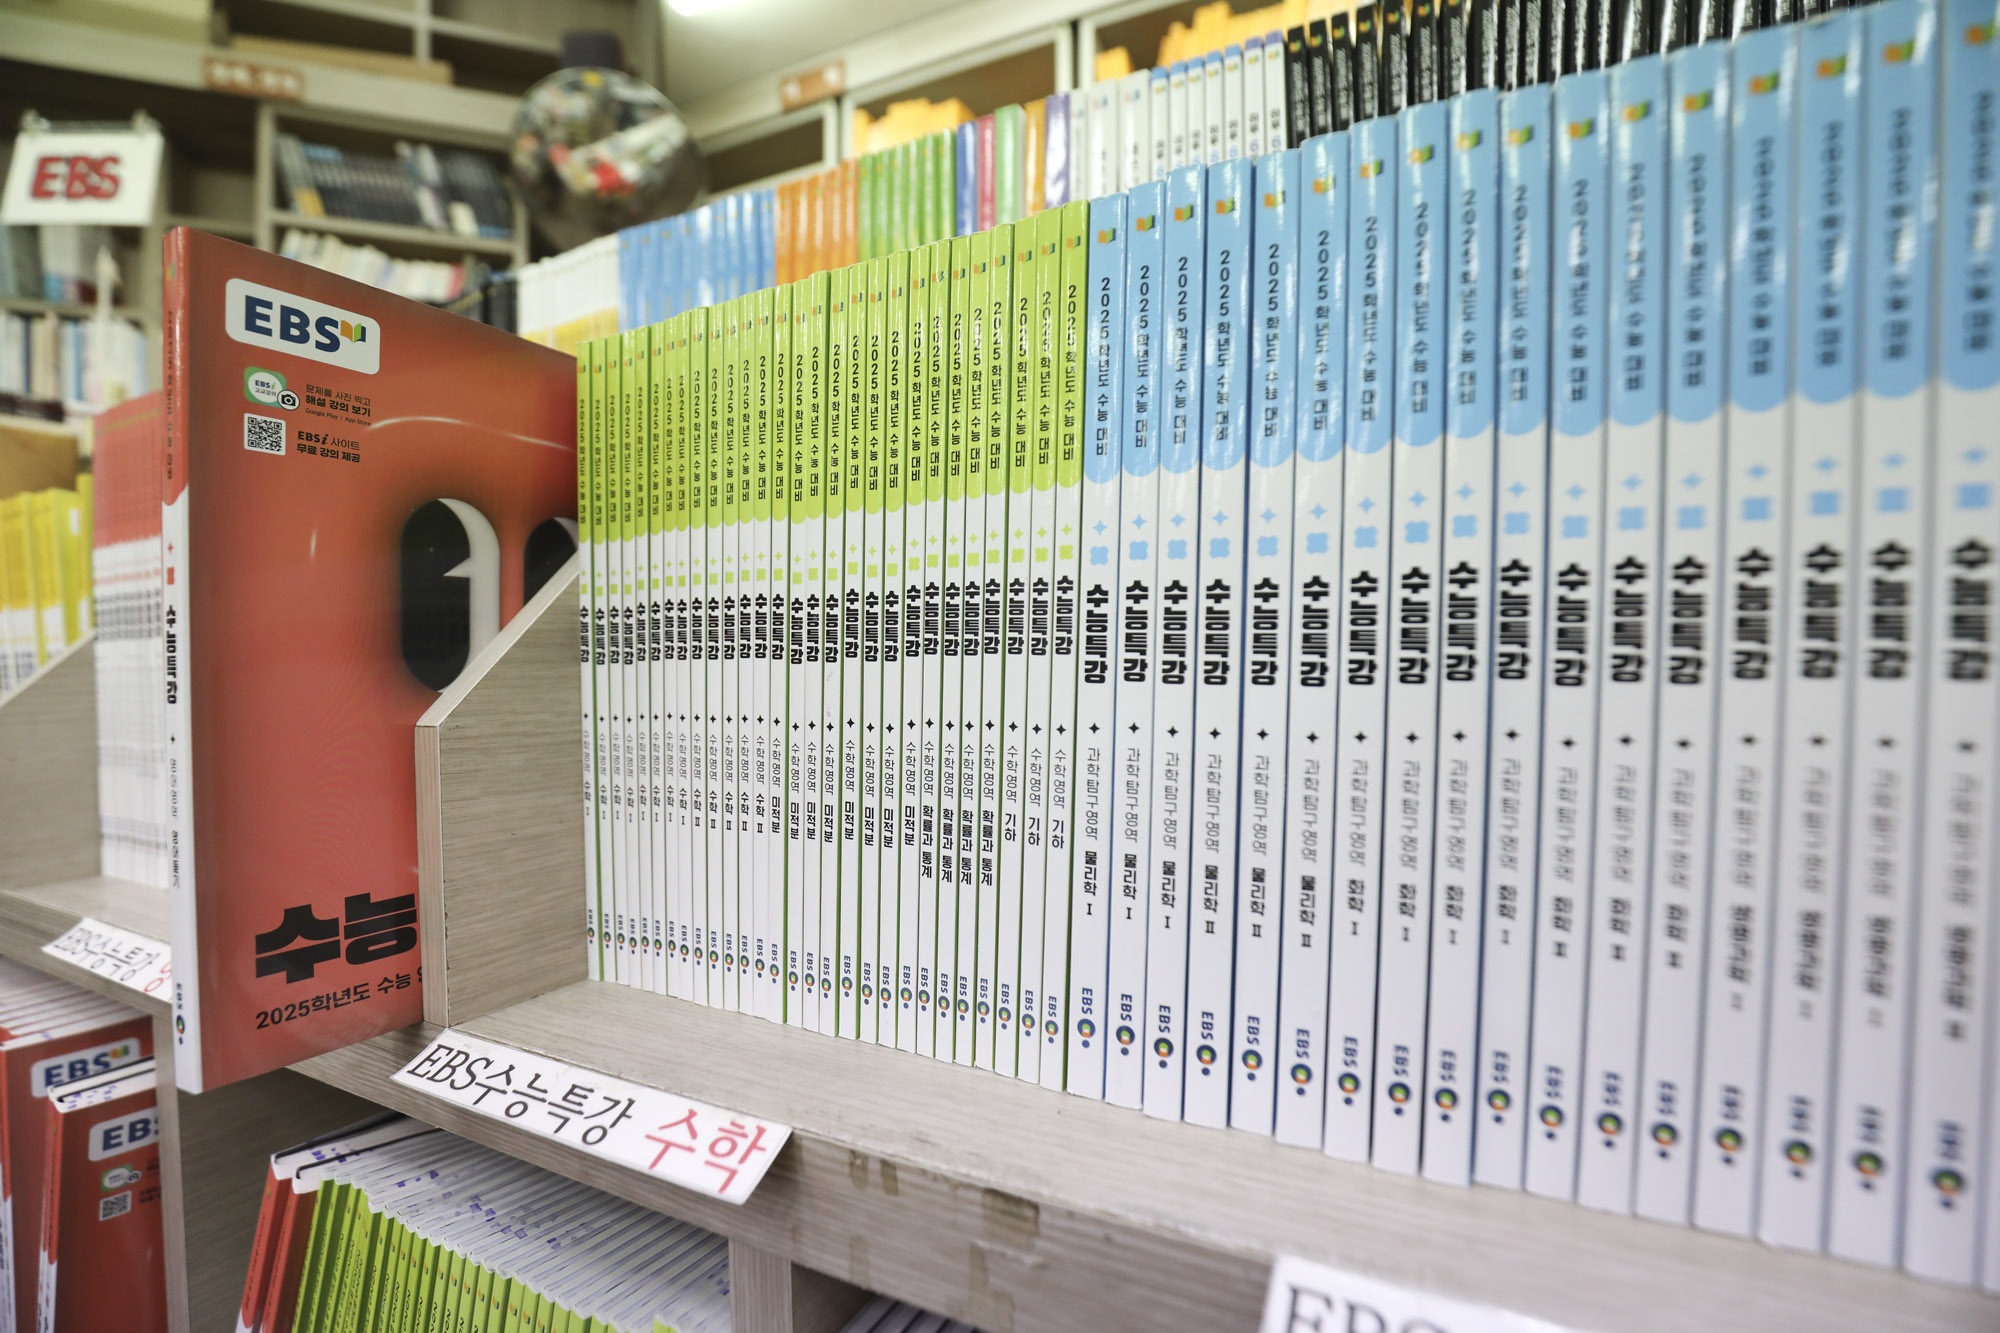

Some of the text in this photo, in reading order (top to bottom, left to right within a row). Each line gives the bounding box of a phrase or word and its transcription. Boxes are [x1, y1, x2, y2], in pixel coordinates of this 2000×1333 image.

[30, 155, 121, 200] EBS
[245, 294, 341, 353] EBS
[255, 380, 276, 390] EBSi
[305, 395, 371, 417] 해설 강의 보기
[306, 384, 371, 406] 문제를 사진 찍고
[1097, 393, 1109, 421] 수능
[1137, 384, 1149, 413] 수능
[1217, 376, 1229, 405] 수능
[298, 430, 360, 451] EBSi 사이트
[305, 408, 325, 417] Google
[326, 412, 339, 420] Play
[345, 416, 357, 424] App
[931, 421, 940, 446] 수능
[991, 413, 1001, 438] 수능
[1016, 409, 1027, 435] 수능
[1096, 427, 1108, 455] 대비
[1136, 419, 1148, 447] 대비
[1215, 411, 1229, 440] 대비
[296, 443, 361, 463] 무료 강의 제공
[694, 462, 701, 482] 수능
[742, 452, 749, 475] 수능
[776, 448, 784, 472] 수능
[851, 436, 859, 460] 수능
[890, 434, 899, 458] 수능
[890, 463, 899, 488] 대비
[930, 451, 940, 477] 대비
[991, 443, 1000, 469] 대비
[1016, 441, 1026, 467] 대비
[694, 487, 701, 507] 대비
[742, 479, 749, 501] 대비
[776, 476, 784, 498] 대비
[850, 465, 859, 488] 대비
[579, 606, 590, 662] 수능특강
[595, 608, 606, 666] 수능특강
[609, 606, 620, 664] 수능특강
[623, 606, 634, 664] 수능특강
[636, 602, 647, 662] 수능특강
[648, 600, 661, 662] 수능특강
[664, 598, 675, 660] 수능특강
[677, 598, 688, 660] 수능특강
[691, 598, 703, 660] 수능특강
[707, 598, 720, 660] 수능특강
[723, 596, 736, 660] 수능특강
[739, 594, 752, 658] 수능특강
[754, 594, 768, 658] 수능특강
[771, 594, 785, 660] 수능특강
[790, 598, 804, 664] 수능특강
[806, 594, 820, 662] 수능특강
[825, 594, 839, 662] 수능특강
[844, 588, 860, 658] 수능특강
[864, 592, 879, 662] 수능특강
[884, 590, 899, 662] 수능특강
[905, 584, 921, 656] 수능특강
[922, 582, 940, 656] 수능특강
[944, 582, 961, 656] 수능특강
[964, 582, 981, 656] 수능특강
[984, 578, 1001, 654] 수능특강
[1007, 578, 1025, 654] 수능특강
[1030, 578, 1049, 656] 수능특강
[1055, 576, 1074, 654] 수능특강
[1084, 584, 1109, 684] 수능특강
[1123, 580, 1149, 682] 수능특강
[1161, 580, 1188, 684] 수능특강
[1203, 578, 1231, 686] 수능특강
[1251, 578, 1279, 686] 수능특강
[1300, 576, 1329, 686] 수능특강
[1348, 572, 1378, 686] 수능특강
[1399, 566, 1430, 684] 수능특강
[1446, 562, 1478, 682] 수능특강
[1498, 560, 1530, 680] 수능특강
[1554, 564, 1588, 686] 수능특강
[1611, 556, 1645, 682] 수능특강
[166, 604, 178, 704] 수능특강
[693, 733, 701, 781] 수학영역
[741, 735, 749, 782] 수학영역
[772, 738, 781, 833] 수학영역 미적분
[694, 788, 702, 811] 수학
[741, 792, 749, 815] 수학
[845, 740, 855, 840] 수학영역 미적분
[884, 746, 894, 848] 수학영역 미적분
[922, 741, 934, 878] 수학영역 확률과 통계
[981, 744, 995, 886] 수학영역 확률과 통계
[1004, 745, 1018, 842] 수학영역 기하
[1086, 748, 1100, 841] 과학탐구영역
[1125, 748, 1141, 843] 과학탐구영역
[1205, 754, 1222, 854] 과학탐구영역
[1084, 851, 1097, 896] 물리학
[1123, 853, 1137, 899] 물리학
[1203, 865, 1218, 913] 물리학
[255, 892, 417, 984] 수능
[256, 982, 371, 1030] 2025학년도
[377, 972, 412, 994] 수능
[980, 978, 988, 998] EBS
[1081, 987, 1093, 1015] EBS
[1121, 994, 1132, 1021] EBS
[1201, 1011, 1214, 1040] EBS
[44, 1051, 112, 1088] EBS
[102, 1117, 159, 1151] EB
[407, 1044, 767, 1193] EBS수능특강 수학
